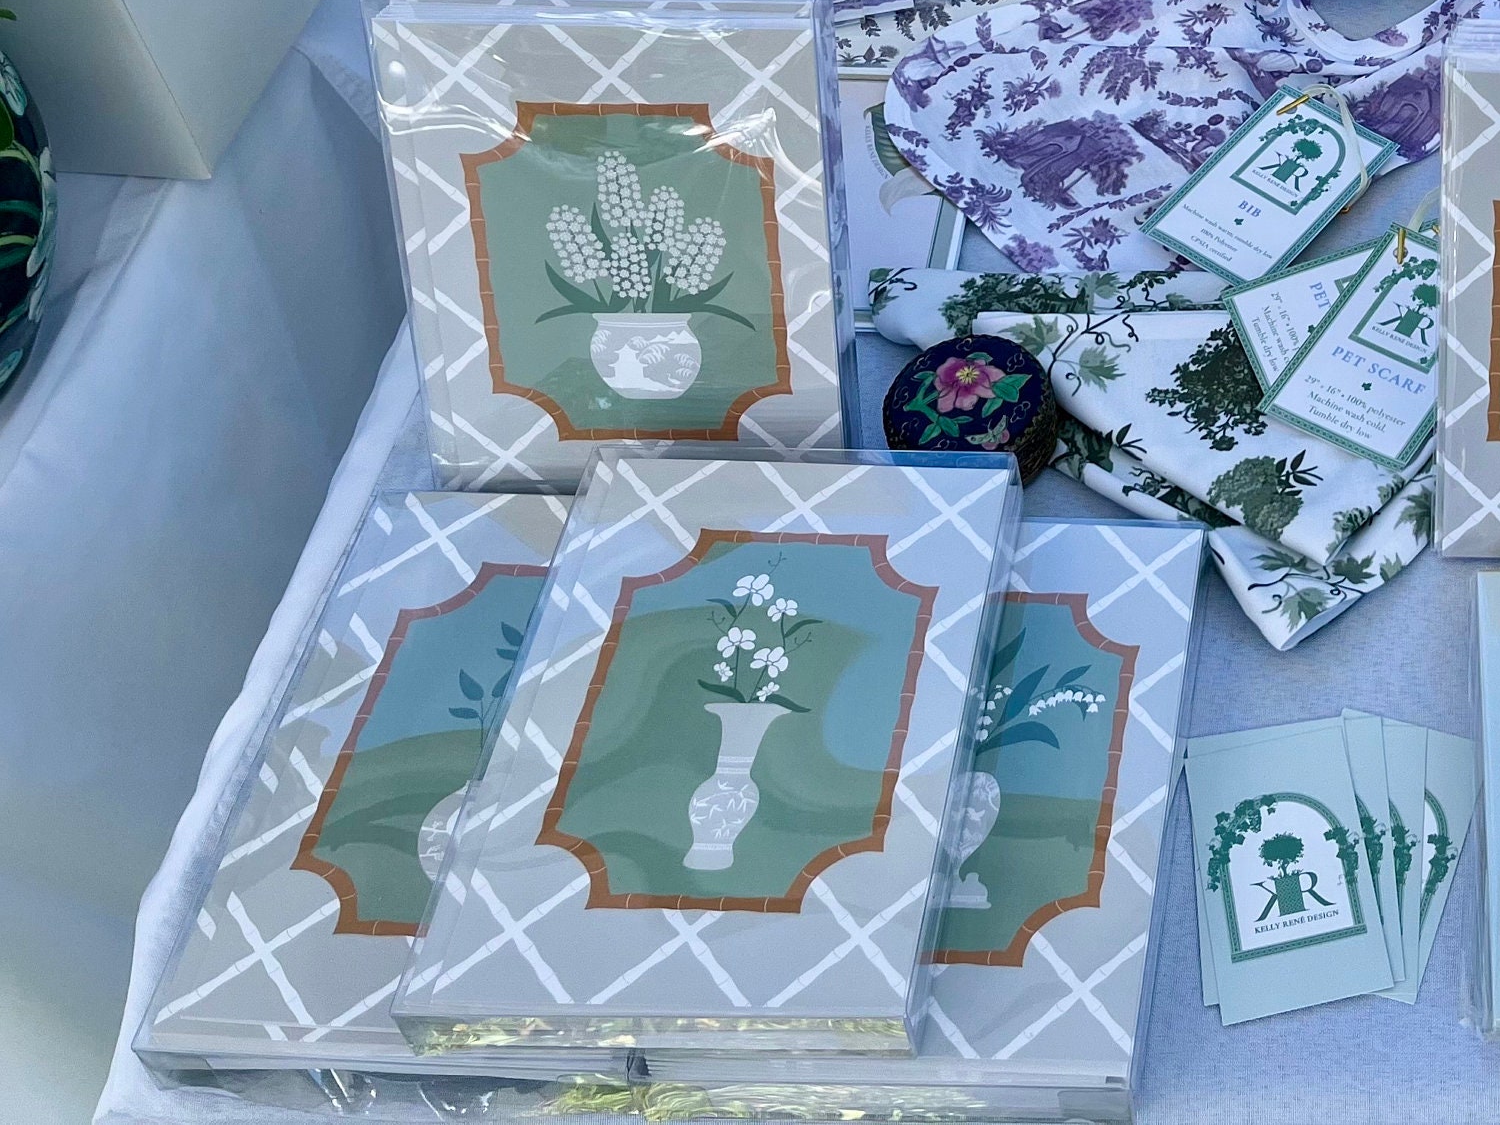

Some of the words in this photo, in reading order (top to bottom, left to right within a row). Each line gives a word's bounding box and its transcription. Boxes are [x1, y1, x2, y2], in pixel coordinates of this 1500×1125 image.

[1238, 200, 1261, 217] BIB
[1309, 282, 1331, 309] PET
[1251, 317, 1269, 344] Tumble
[1263, 305, 1279, 337] Machine
[1331, 345, 1366, 371] PET
[1368, 362, 1427, 396] SCARF
[1309, 391, 1344, 412] Machine
[1345, 409, 1365, 423] wash
[1309, 405, 1340, 425] Tumble
[1340, 421, 1354, 433] dry
[1356, 428, 1371, 439] low
[1347, 394, 1367, 409] 100%
[1366, 406, 1406, 427] polyester
[1254, 922, 1281, 935] KELLY
[1307, 909, 1340, 922] DESIGN
